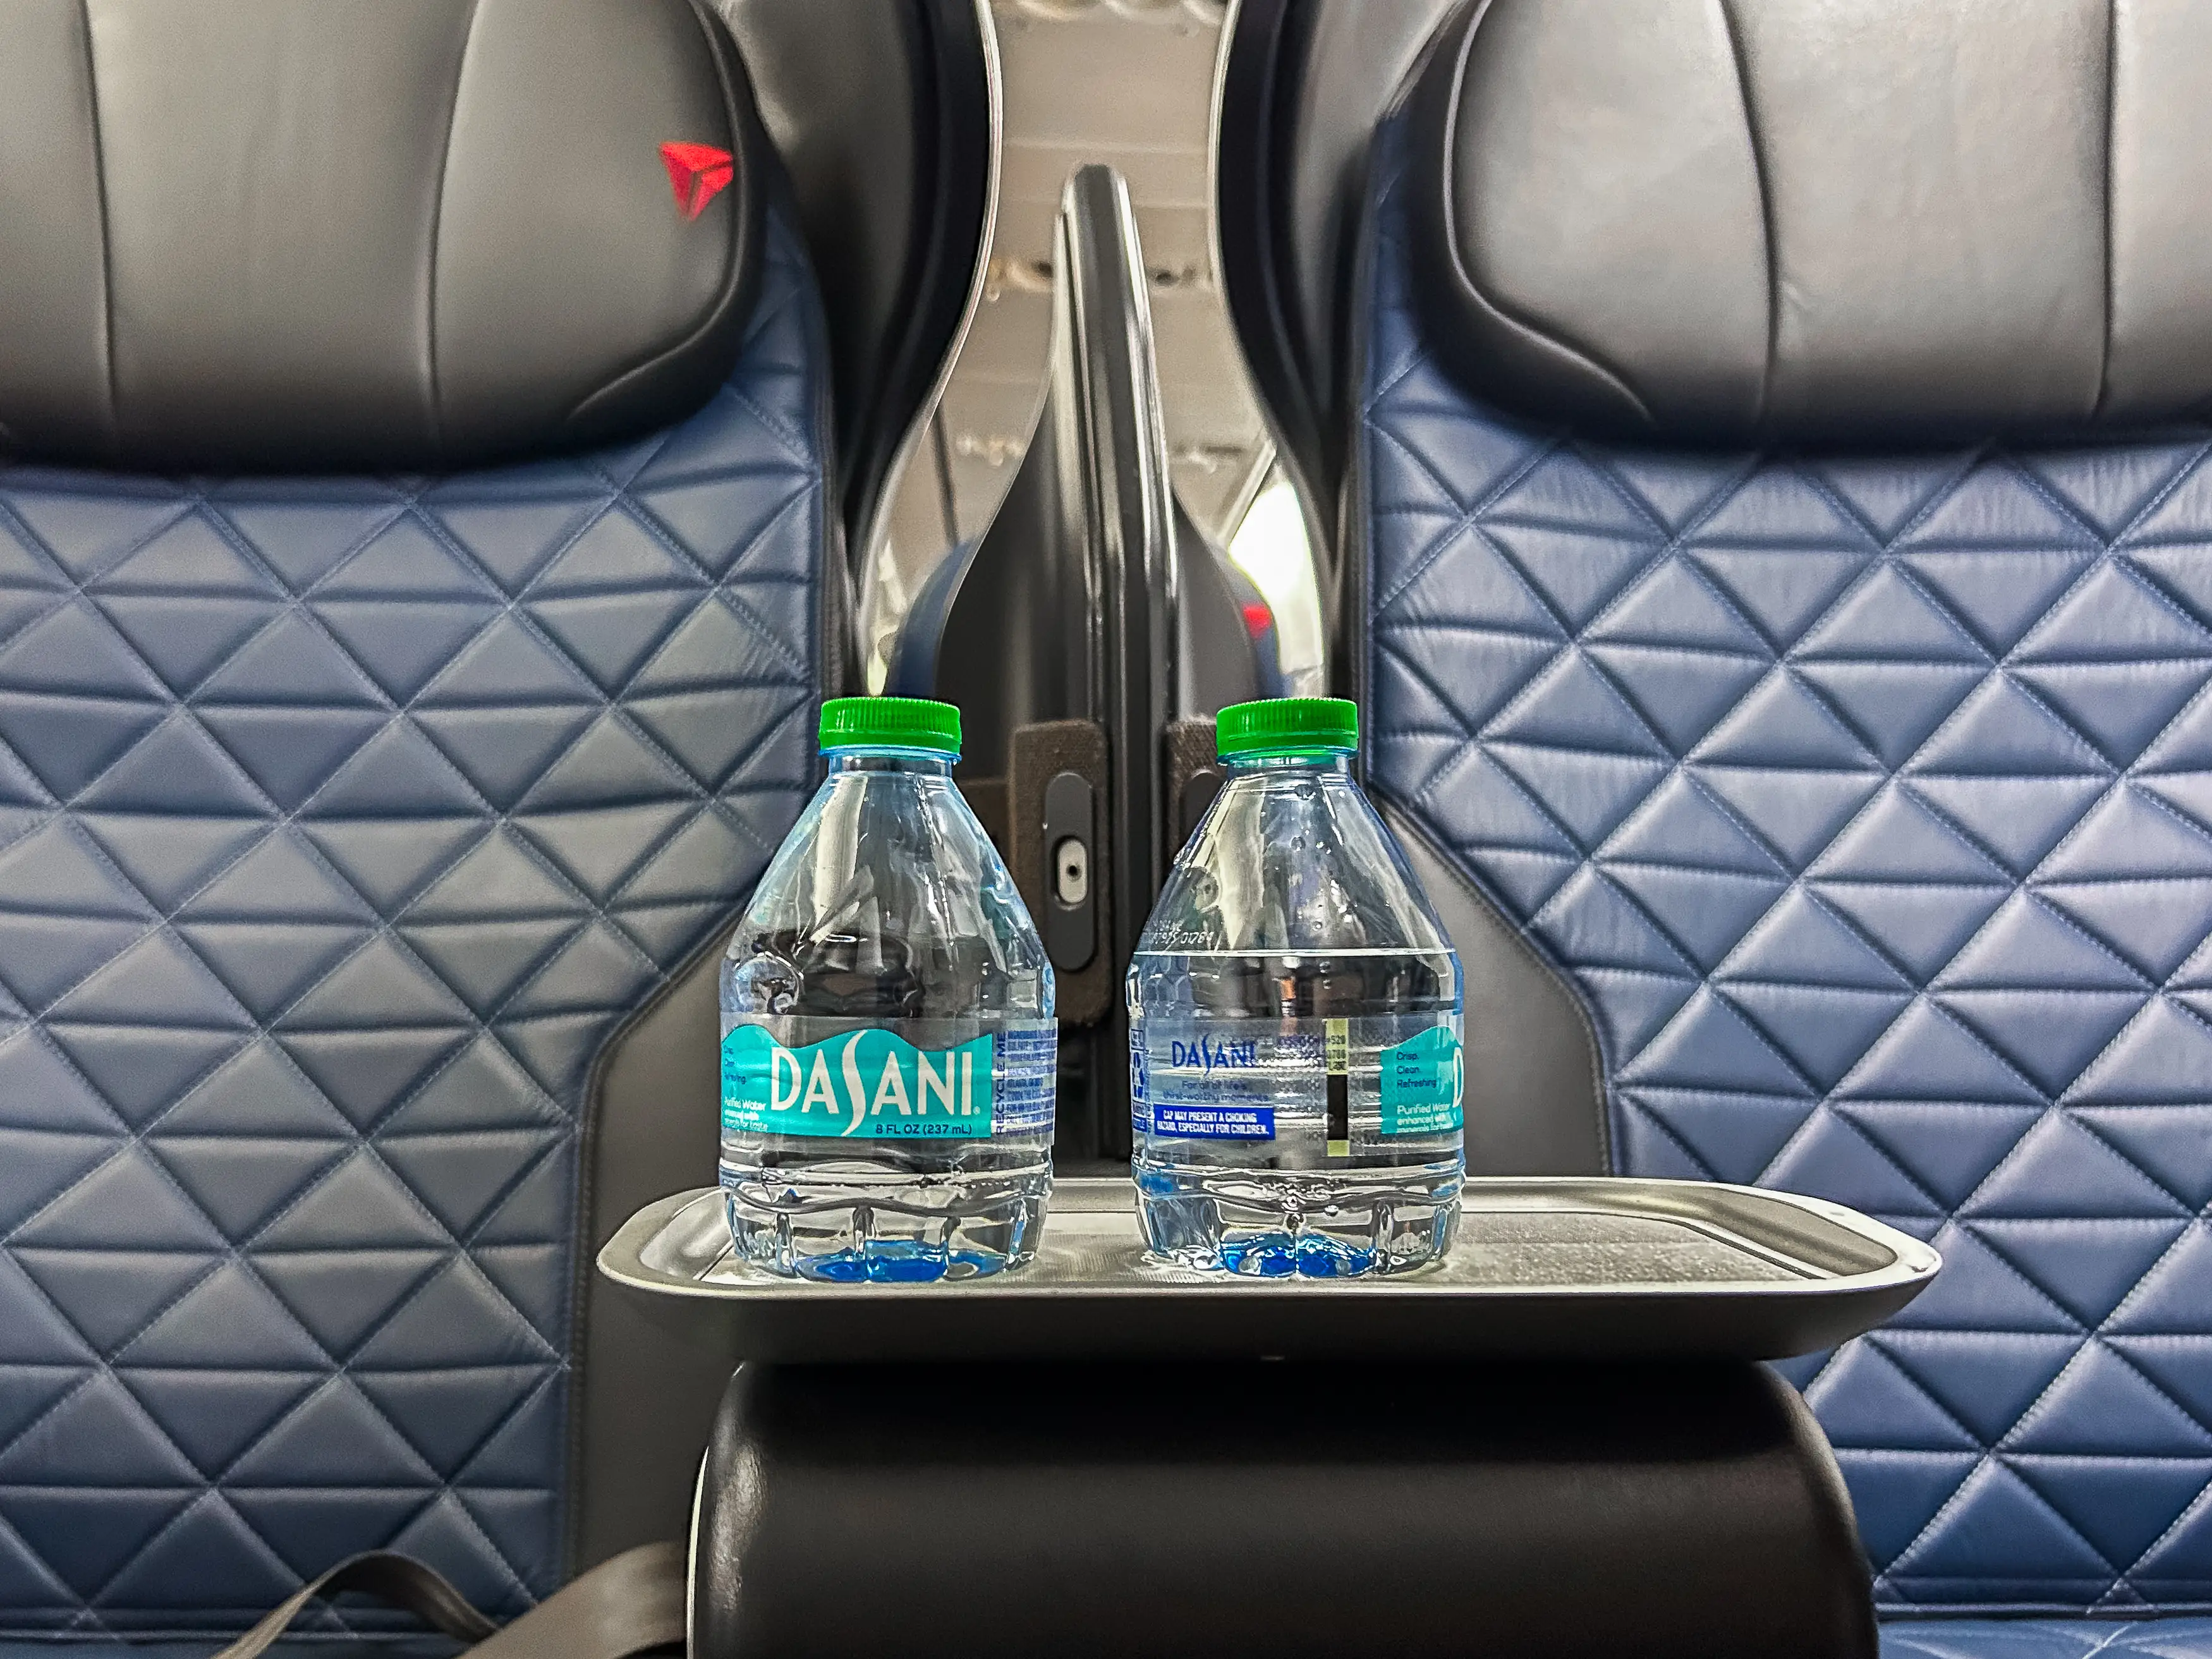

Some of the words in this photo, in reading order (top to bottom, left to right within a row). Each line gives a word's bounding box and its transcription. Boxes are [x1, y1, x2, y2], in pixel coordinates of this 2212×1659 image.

[997, 1031, 1006, 1058] ME
[1172, 1033, 1255, 1076] DASANI
[771, 1030, 972, 1137] DASANI
[995, 1062, 1006, 1134] RECYCLE
[1397, 1103, 1431, 1115] Purified
[875, 1124, 884, 1134] 8
[886, 1124, 901, 1134] FL
[904, 1124, 920, 1134] OZ
[923, 1124, 949, 1136] (237
[952, 1124, 972, 1135] mL)
[1218, 1112, 1225, 1122] A
